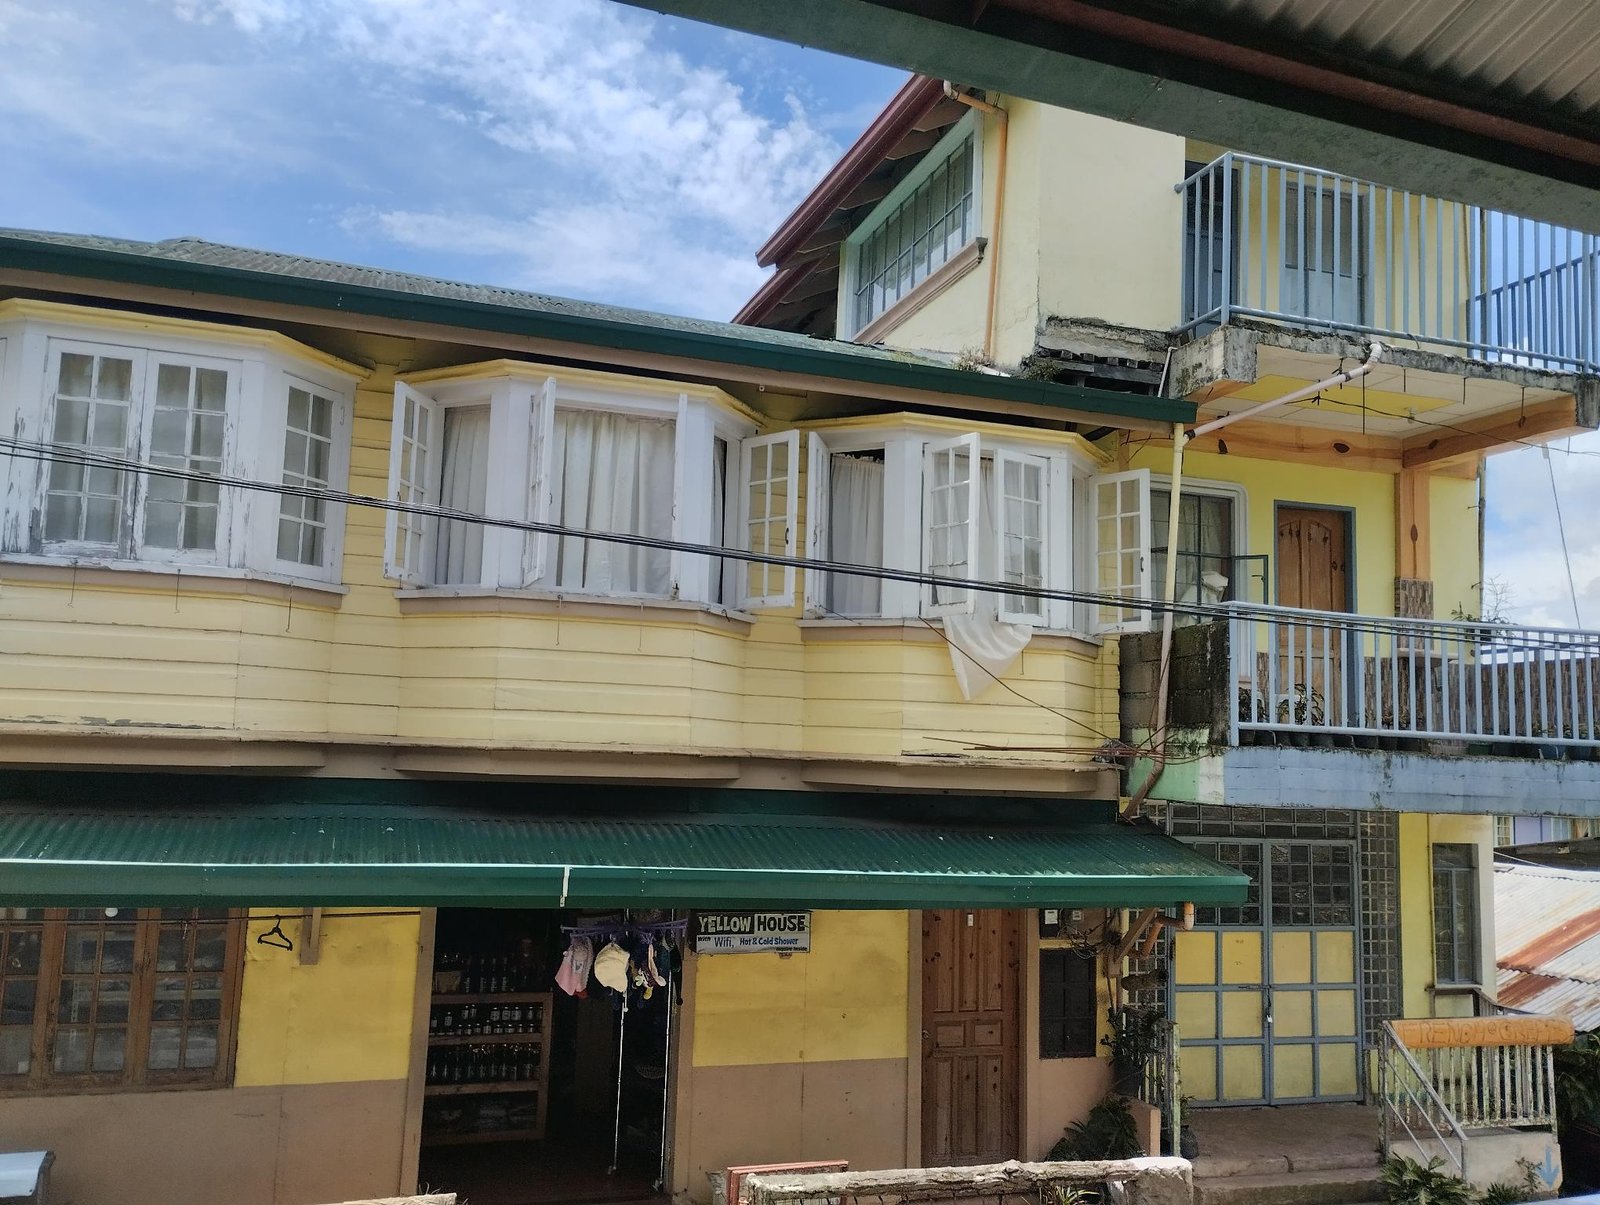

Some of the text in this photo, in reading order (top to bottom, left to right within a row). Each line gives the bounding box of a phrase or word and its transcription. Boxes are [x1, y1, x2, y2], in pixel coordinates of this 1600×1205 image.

[698, 914, 806, 933] YELLOW HOUSE
[739, 937, 752, 946] Hot
[752, 937, 757, 945] &
[758, 937, 773, 945] Cold
[773, 936, 799, 945] Shower
